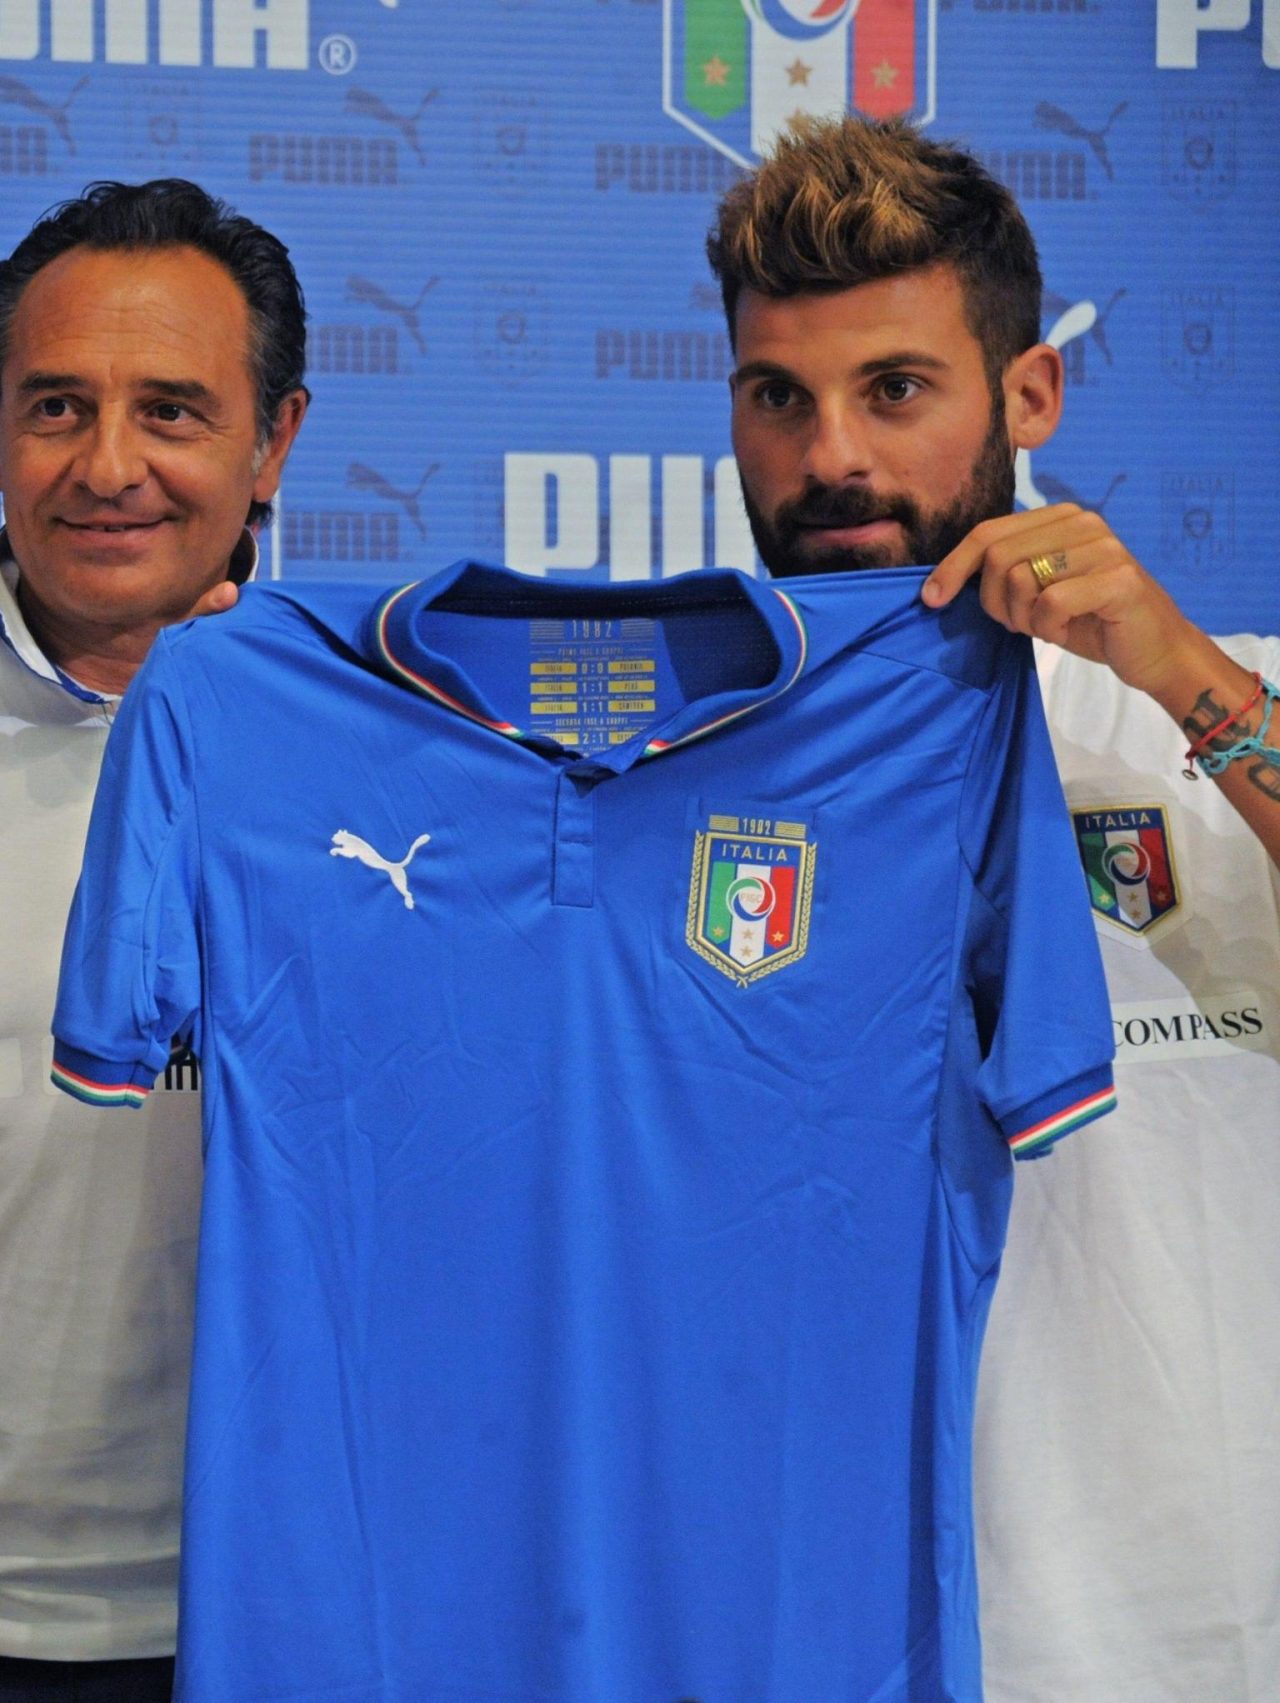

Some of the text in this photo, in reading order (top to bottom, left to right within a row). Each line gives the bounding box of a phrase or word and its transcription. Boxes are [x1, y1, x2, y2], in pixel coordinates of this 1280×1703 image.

[248, 135, 397, 186] PUMA
[1085, 812, 1151, 828] ITALIA
[722, 844, 787, 861] ITALIA
